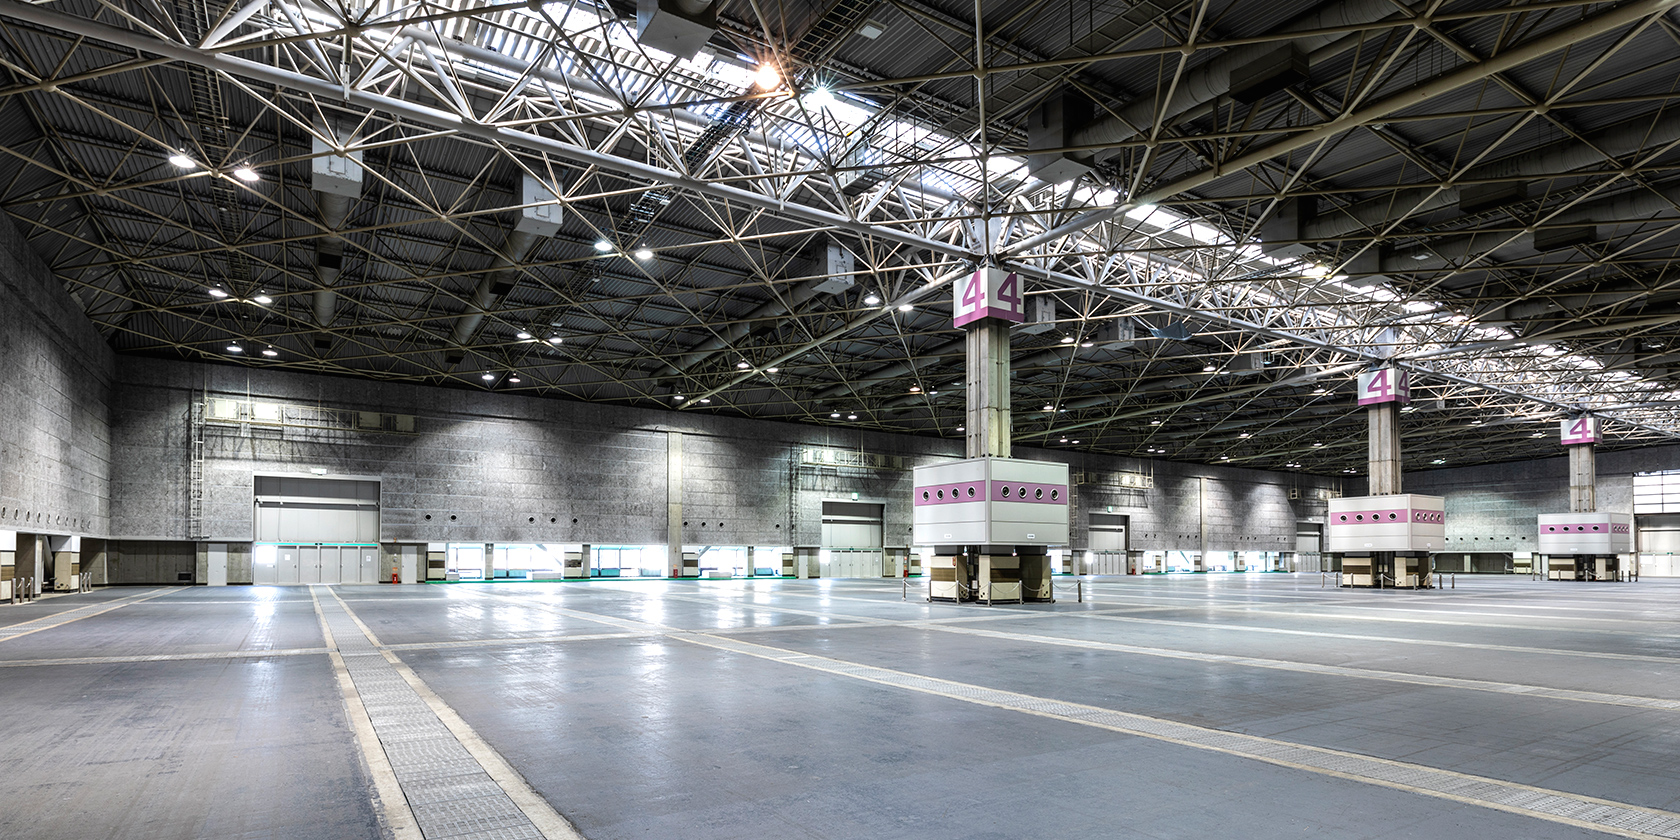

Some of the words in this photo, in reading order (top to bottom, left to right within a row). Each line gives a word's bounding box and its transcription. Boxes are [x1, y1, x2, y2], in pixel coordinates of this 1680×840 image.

[962, 270, 985, 312] 4
[997, 272, 1021, 314] 4
[1367, 369, 1392, 396] 4
[1398, 371, 1409, 398] 4
[1569, 418, 1591, 439] 4
